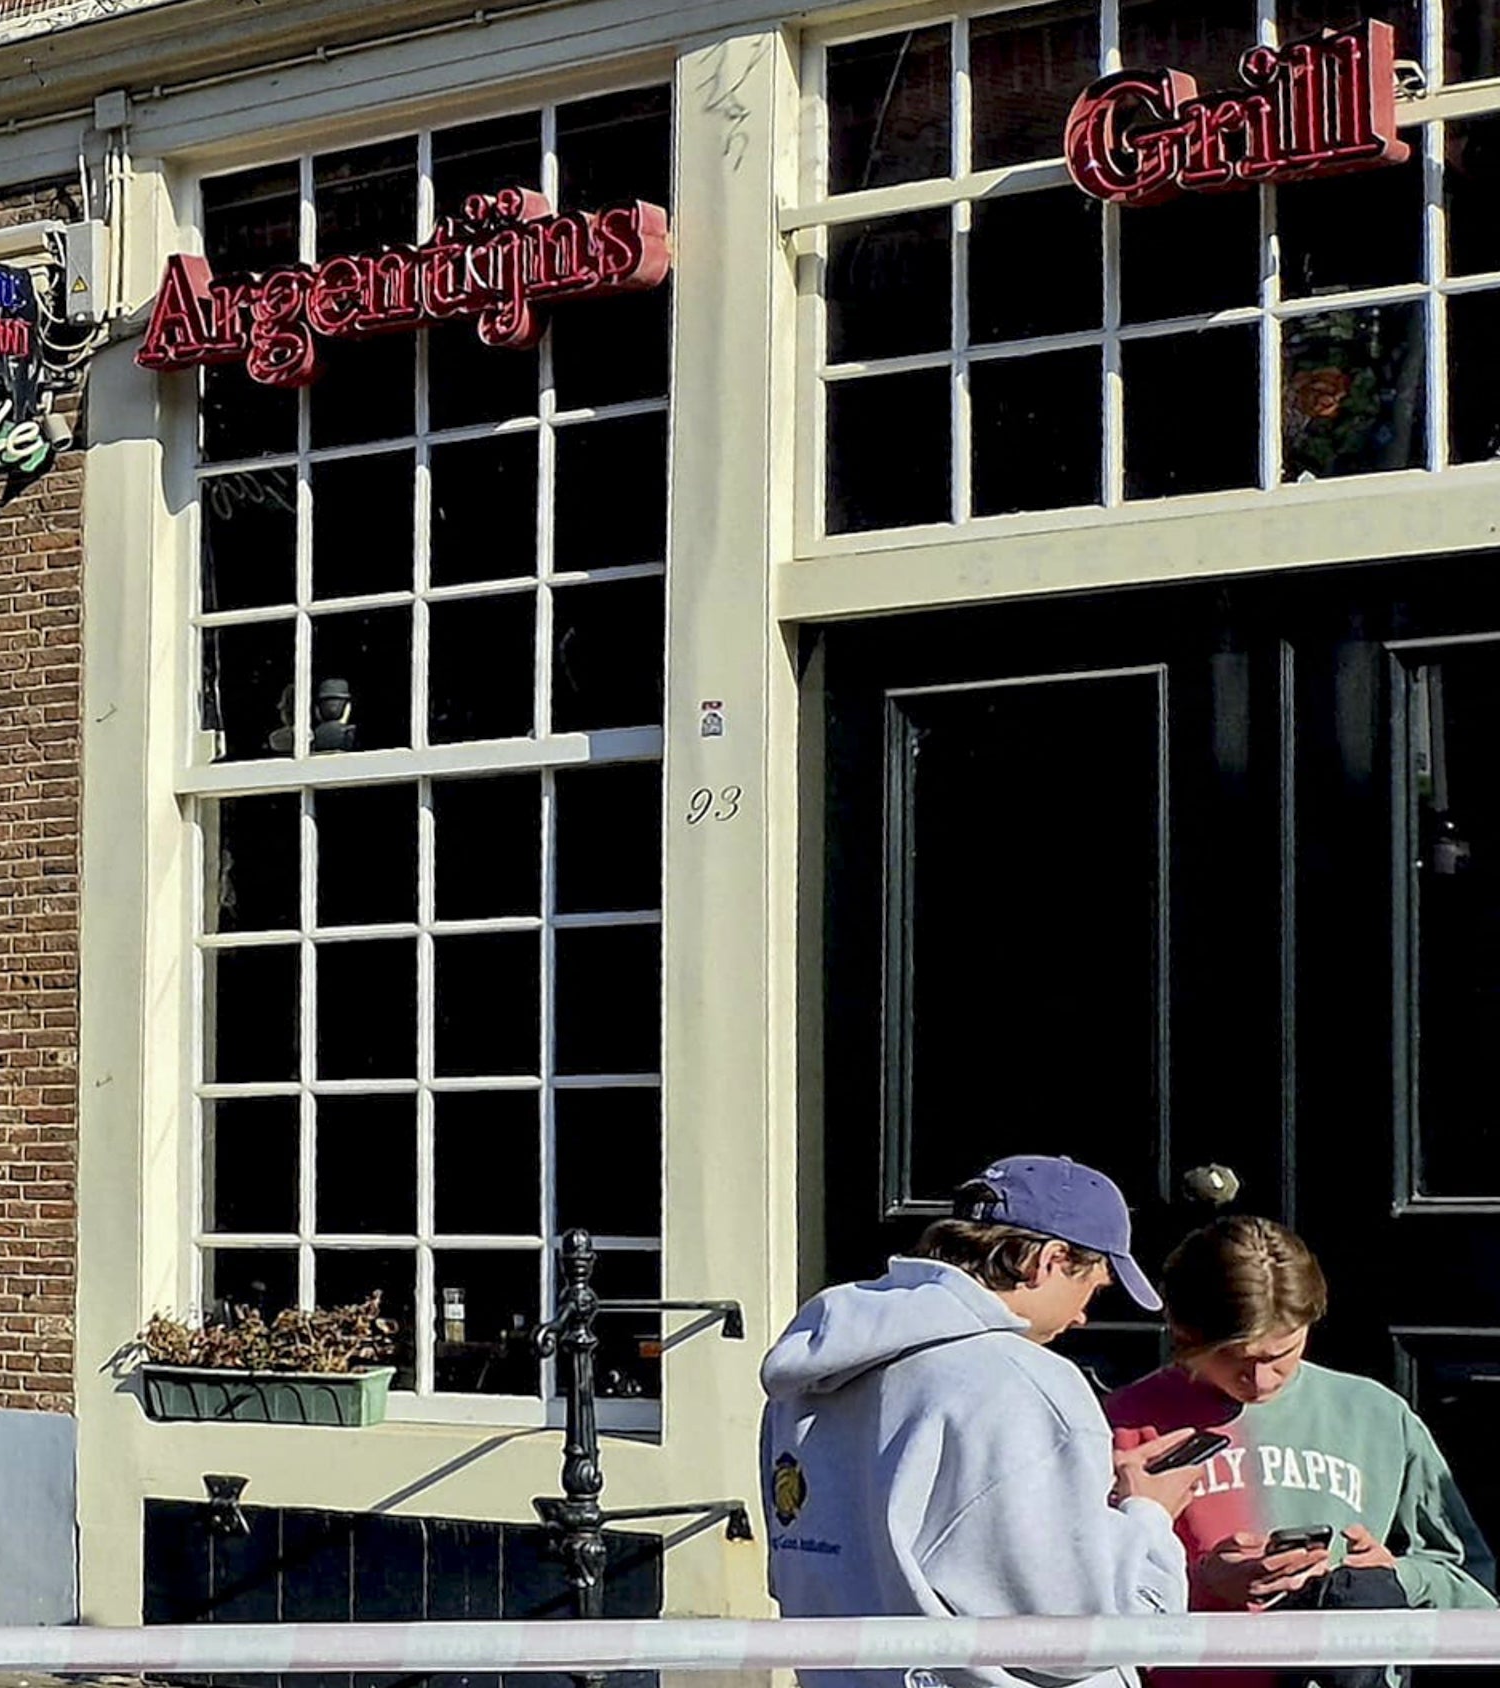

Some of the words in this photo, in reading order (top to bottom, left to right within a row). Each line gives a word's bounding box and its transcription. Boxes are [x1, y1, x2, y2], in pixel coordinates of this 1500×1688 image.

[1064, 18, 1412, 207] Grill
[135, 187, 672, 388] Argentijns
[686, 785, 742, 825] 93
[1257, 1445, 1363, 1513] PAPER
